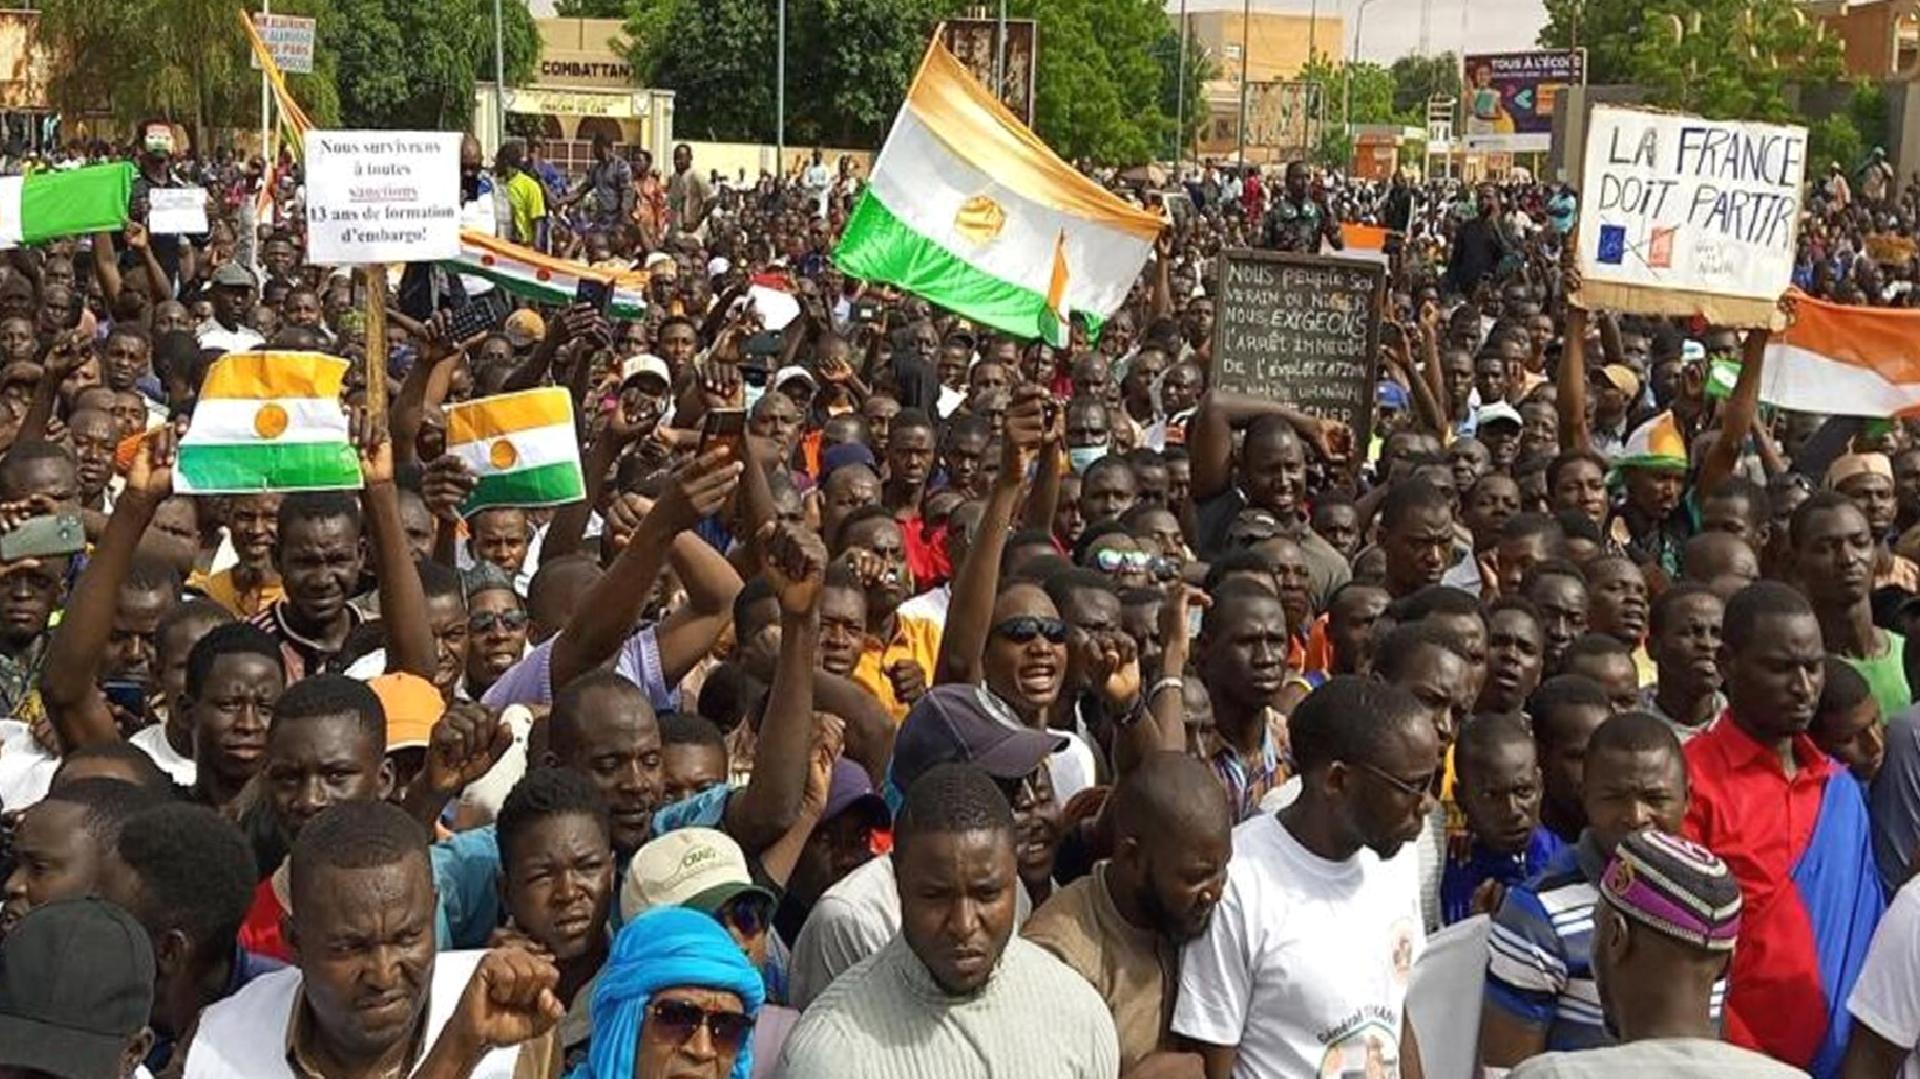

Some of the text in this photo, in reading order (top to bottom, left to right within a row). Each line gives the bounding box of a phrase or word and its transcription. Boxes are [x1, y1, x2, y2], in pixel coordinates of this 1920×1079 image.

[1491, 59, 1521, 70] TOUS
[321, 139, 360, 154] Nous
[1608, 126, 1803, 188] LA FRANCE
[354, 161, 411, 176] à toutes
[349, 184, 418, 198] sanctions
[311, 204, 455, 222] 13 ans de formation
[1687, 183, 1796, 248] PARTIR
[341, 226, 427, 244] d'embargo!
[1270, 308, 1369, 339] EXIGEONS
